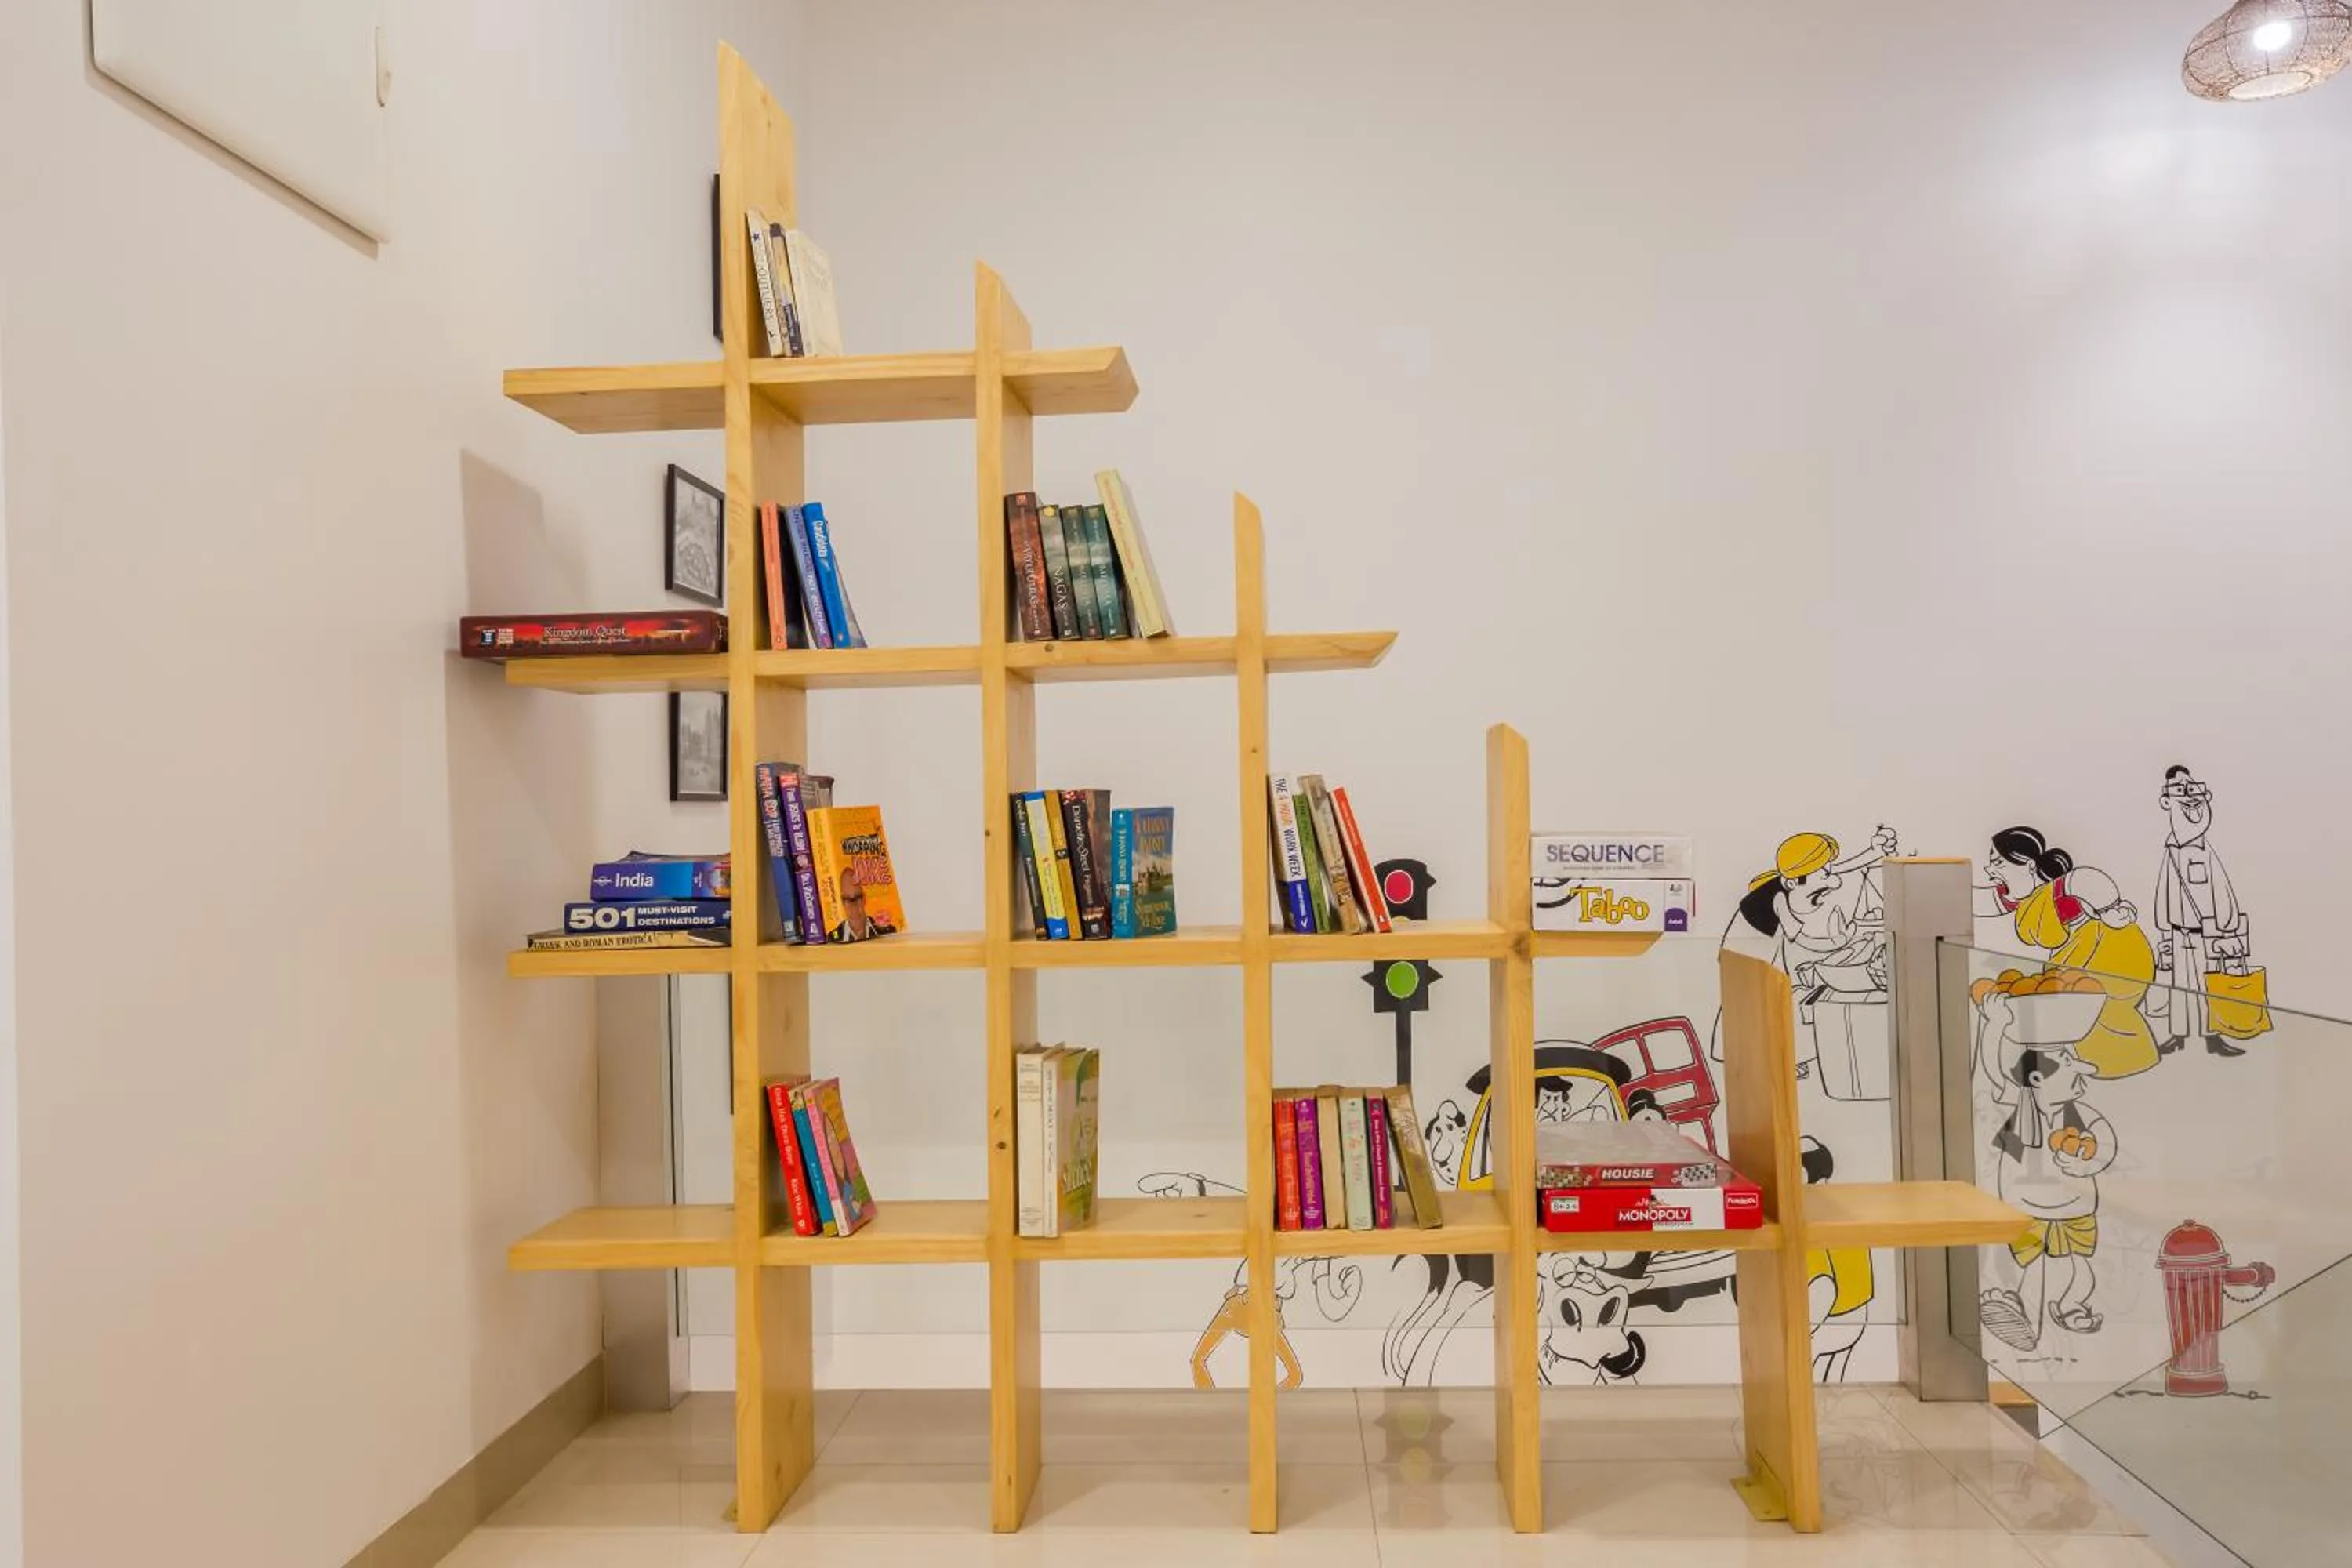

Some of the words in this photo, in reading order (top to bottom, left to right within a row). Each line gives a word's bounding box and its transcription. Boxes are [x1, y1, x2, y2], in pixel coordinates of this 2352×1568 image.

[1054, 565, 1069, 611] NAGAS
[544, 626, 593, 640] Kingdom
[1275, 778, 1288, 793] THE
[1283, 827, 1299, 853] WORK
[1547, 844, 1664, 863] SEQUENCE
[1288, 852, 1302, 877] WEEK
[615, 873, 654, 887] India
[637, 906, 699, 915] MUST-VISIT
[1570, 884, 1650, 924] Taboo
[568, 907, 636, 930] 501
[637, 916, 716, 927] DESTINATIONS
[564, 939, 582, 949] AND
[583, 938, 614, 948] ROMAN
[1602, 1168, 1654, 1179] HOUSIE
[1618, 1209, 1688, 1221] MONOPOLY
